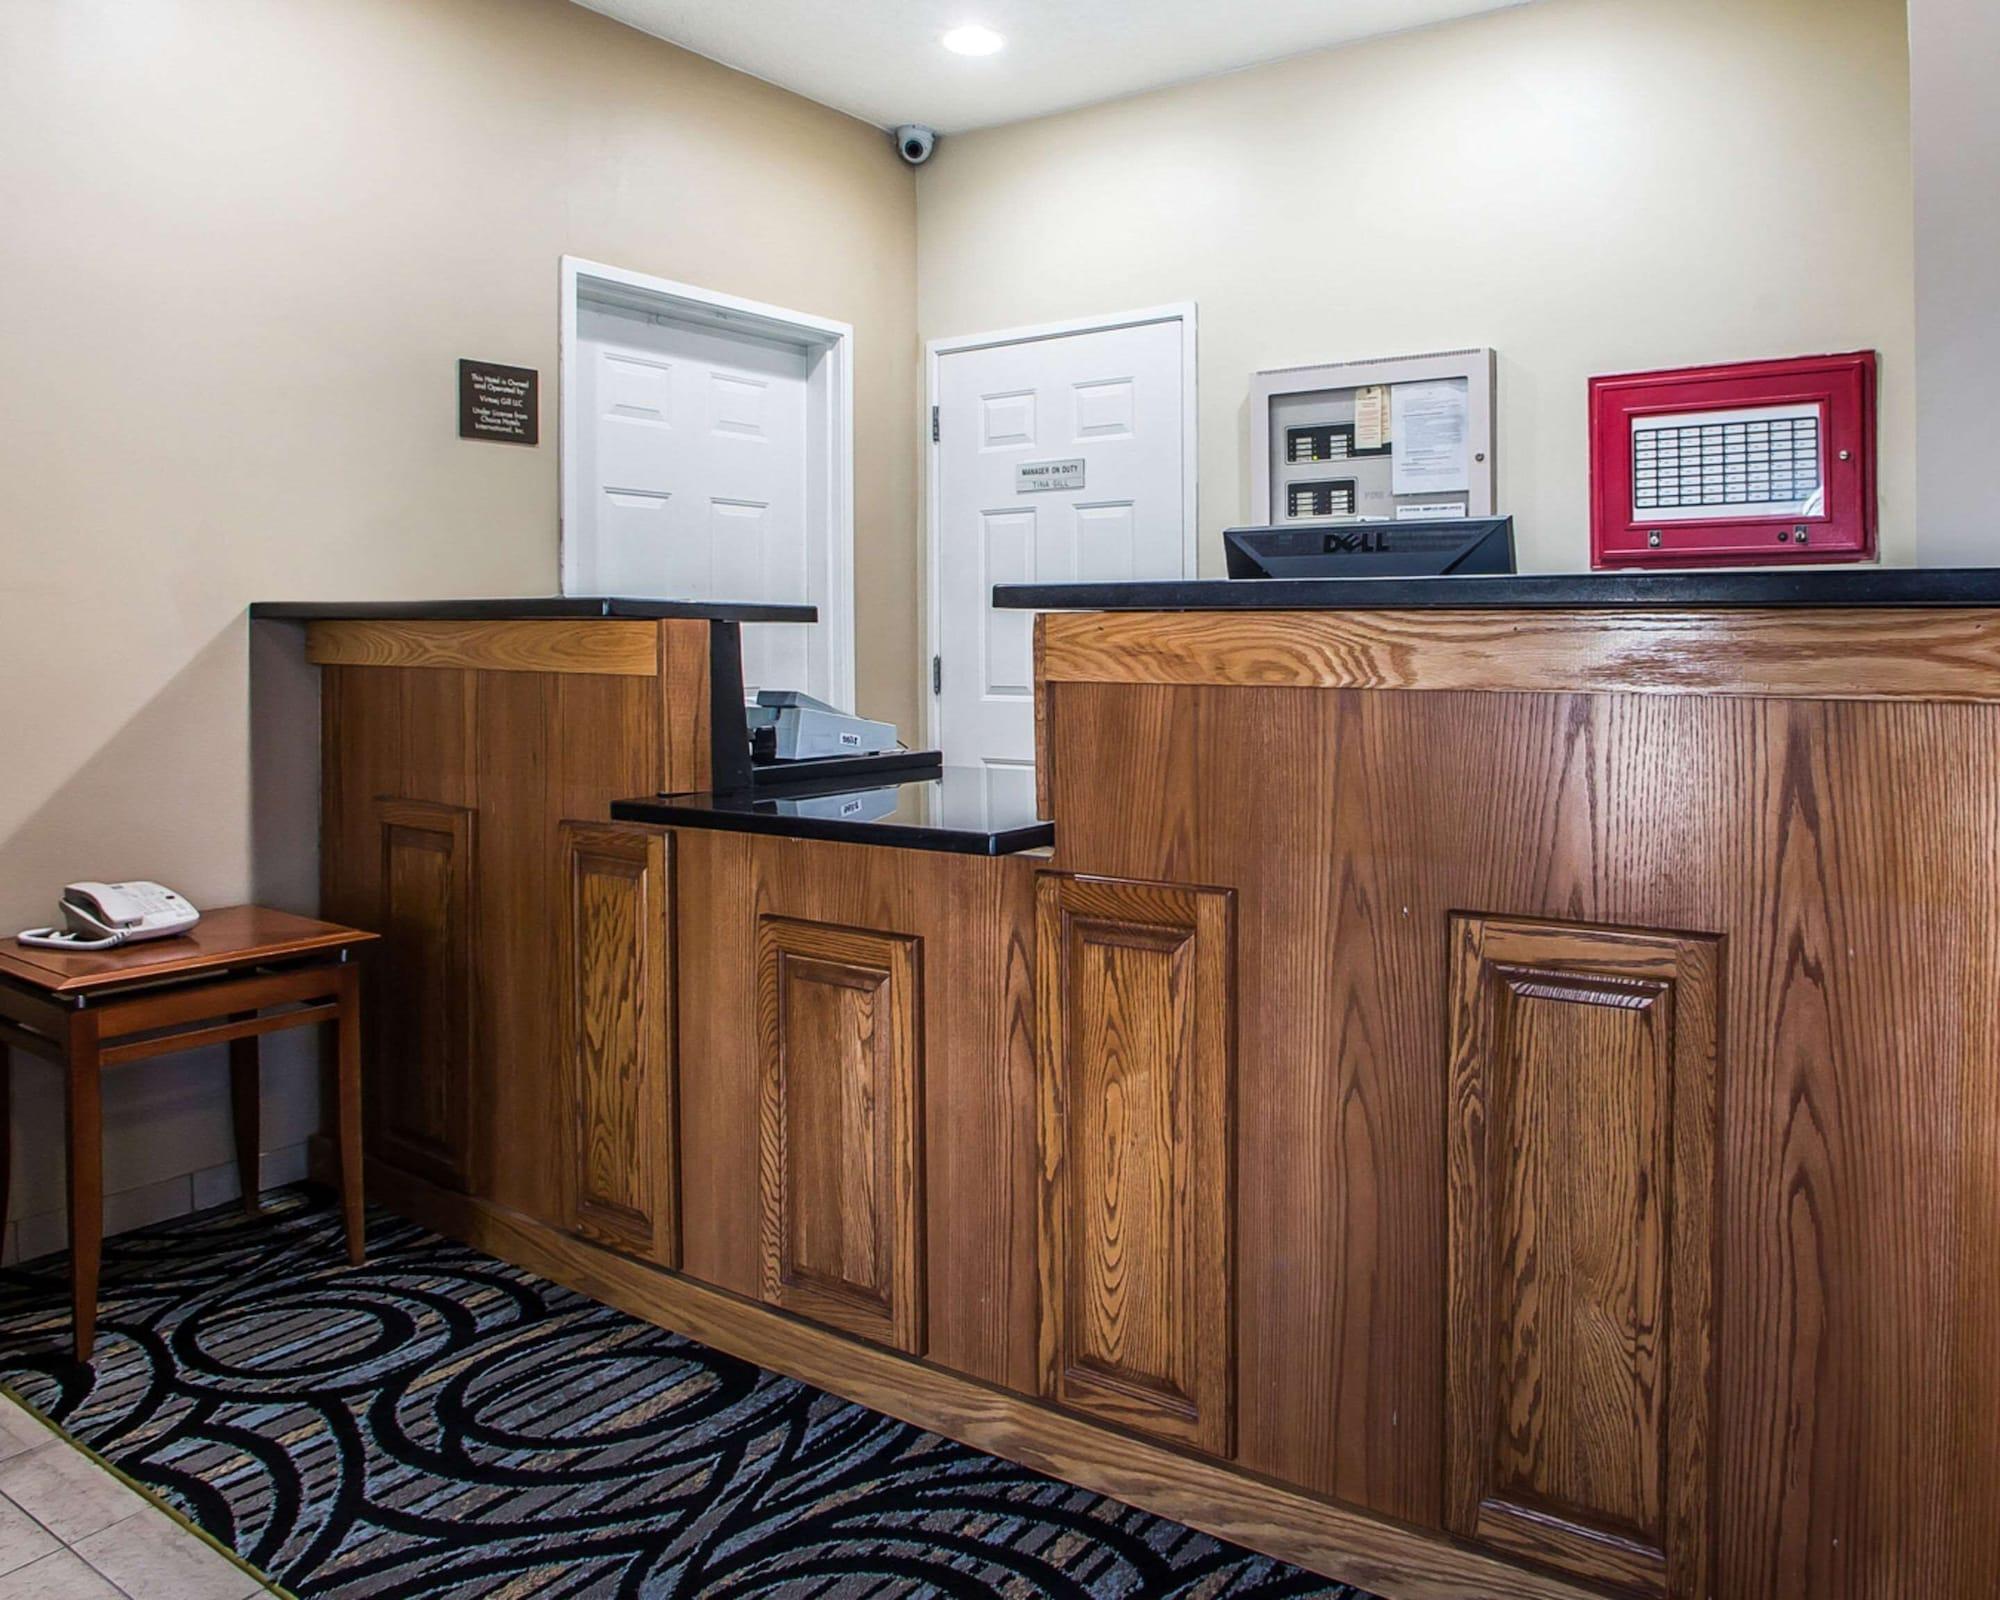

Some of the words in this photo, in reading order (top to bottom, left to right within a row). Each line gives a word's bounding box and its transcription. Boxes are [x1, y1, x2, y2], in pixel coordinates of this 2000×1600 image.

[471, 373, 484, 382] This
[507, 378, 529, 389] Owned
[1022, 467, 1049, 476] MANAGER
[1051, 466, 1061, 474] ON
[1062, 464, 1078, 473] DUTY
[1323, 532, 1392, 553] DELL
